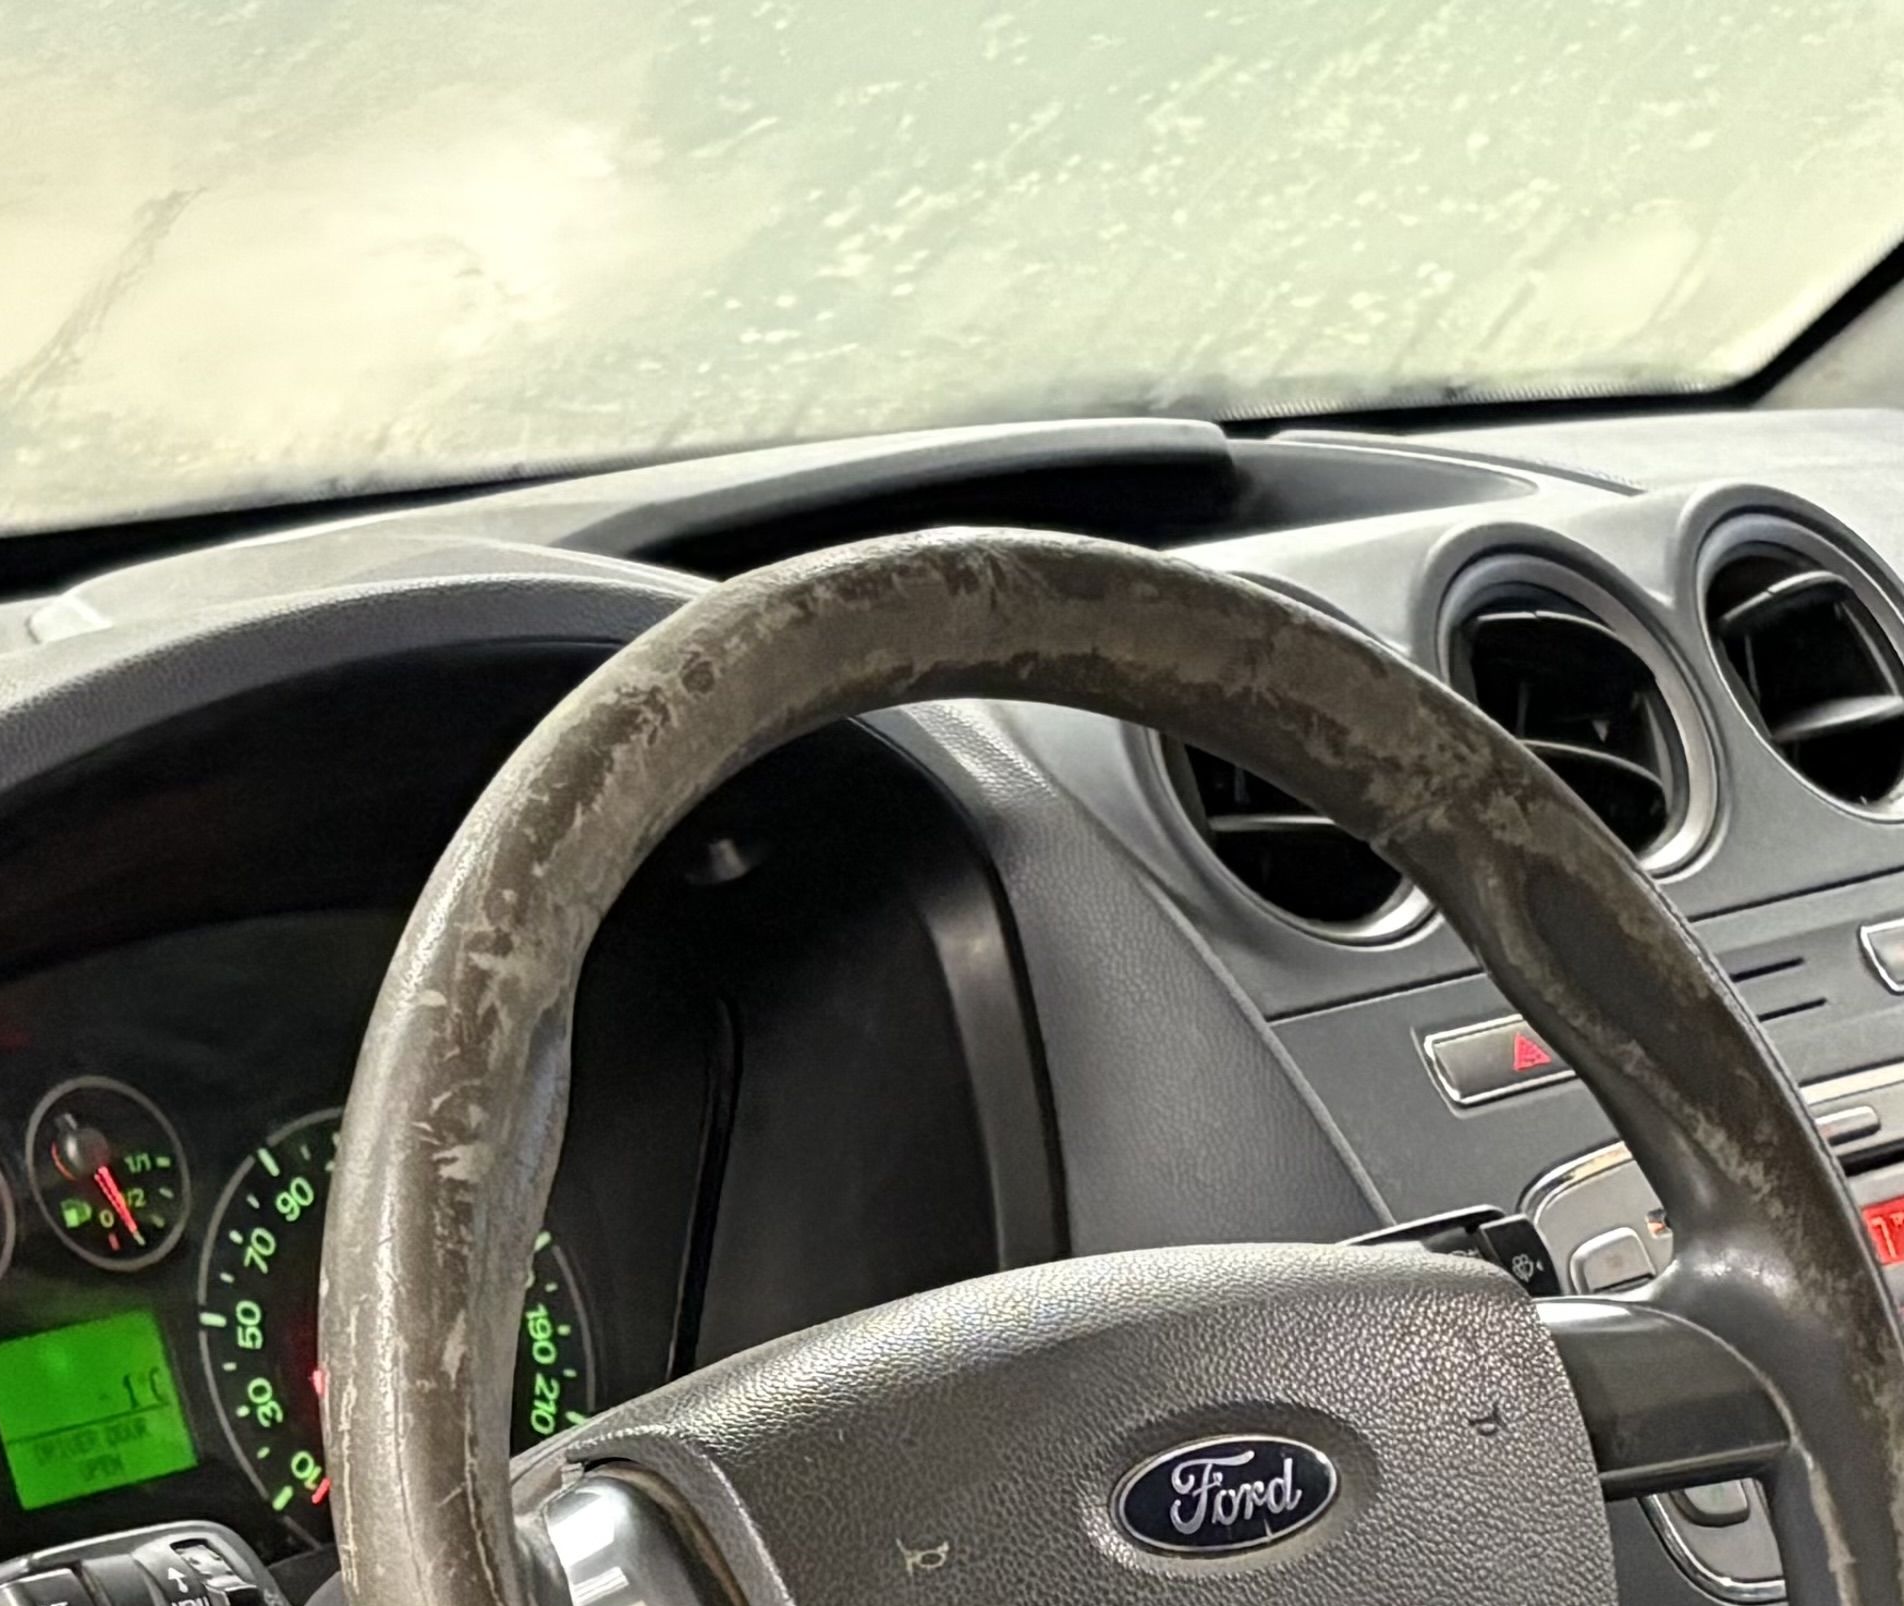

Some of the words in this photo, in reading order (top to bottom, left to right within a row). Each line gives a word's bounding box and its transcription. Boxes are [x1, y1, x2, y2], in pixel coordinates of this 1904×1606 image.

[99, 1207, 115, 1230] 0
[274, 1176, 315, 1222] 90
[242, 1226, 277, 1275] 70
[235, 1300, 264, 1350] 50
[525, 1302, 558, 1366] 190
[247, 1376, 284, 1429] 30
[530, 1371, 561, 1436] 210
[1169, 1450, 1304, 1535] Ford
